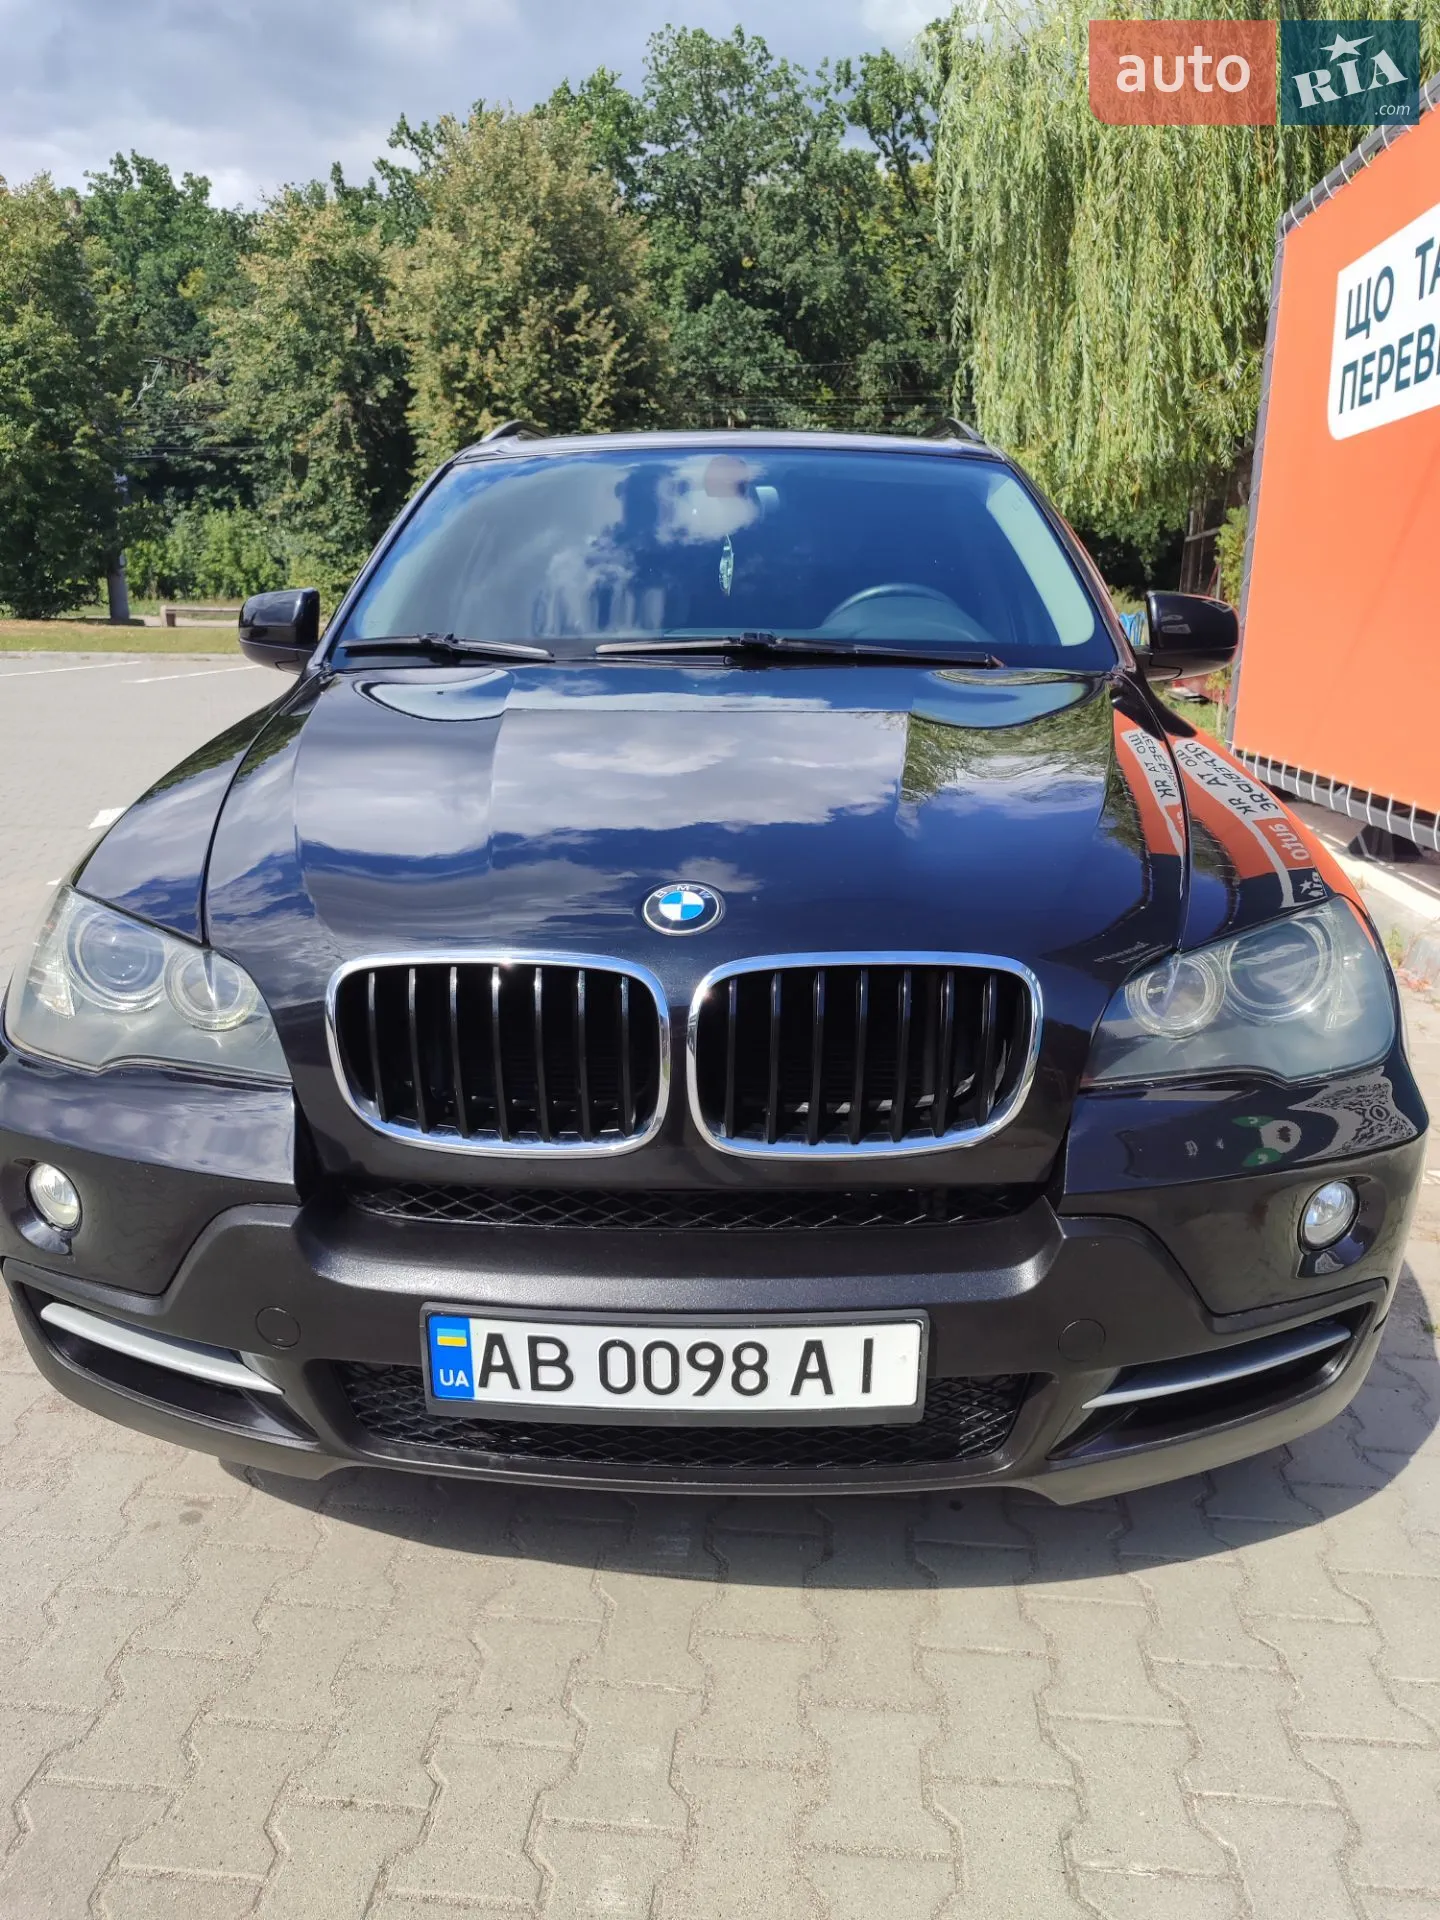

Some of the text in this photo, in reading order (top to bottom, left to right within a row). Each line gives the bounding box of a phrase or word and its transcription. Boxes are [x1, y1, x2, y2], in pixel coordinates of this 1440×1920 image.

[1345, 265, 1395, 341] ЩО
[439, 1367, 470, 1388] UA
[478, 1332, 574, 1392] AB
[598, 1338, 769, 1396] 0098
